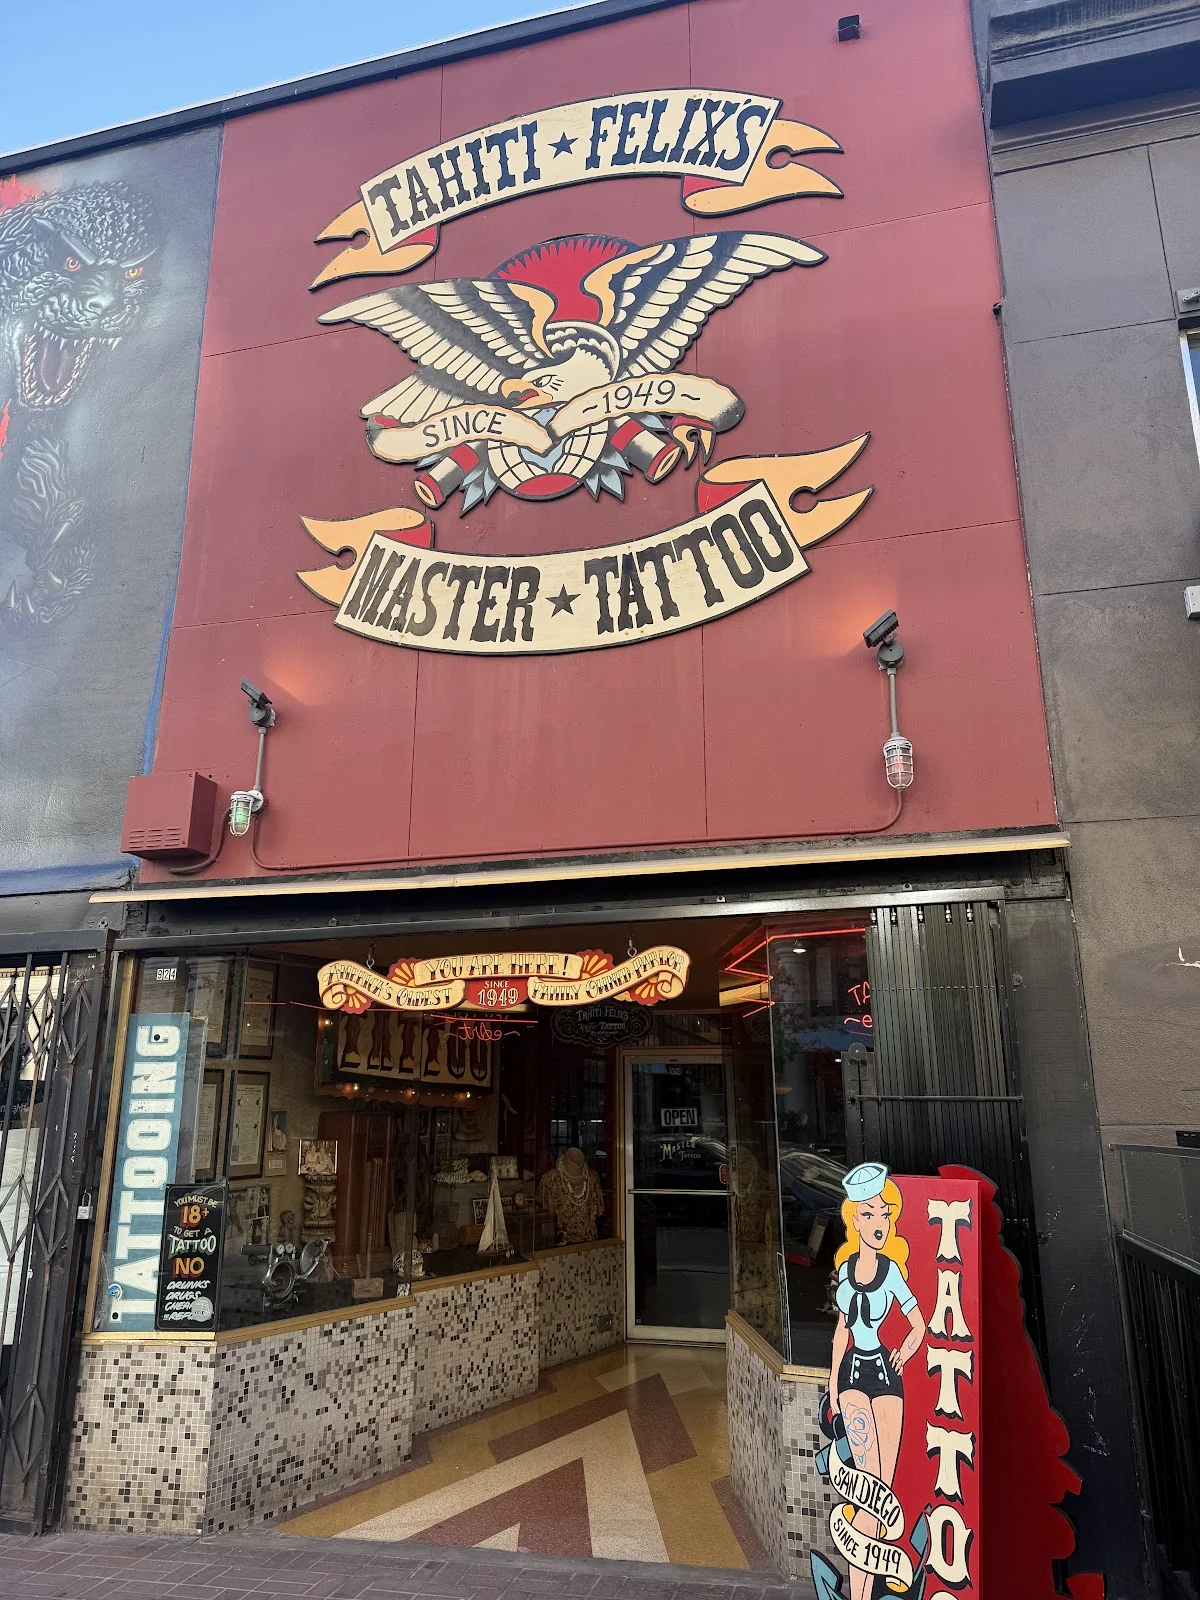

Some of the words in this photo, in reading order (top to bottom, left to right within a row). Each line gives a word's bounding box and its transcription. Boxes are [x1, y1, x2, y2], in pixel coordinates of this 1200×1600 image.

[367, 120, 541, 237] TAHITI
[584, 97, 772, 172] FELIX'S
[422, 410, 507, 448] SINCE
[344, 544, 541, 644] MASTER
[584, 498, 797, 635] TATTOO
[156, 968, 177, 981] 924
[425, 956, 464, 981] YOU
[466, 954, 504, 976] ARE
[508, 953, 569, 976] HERE!
[531, 981, 582, 1001] FAMILY
[585, 966, 631, 999] OWNED
[632, 949, 685, 979] PARLOR
[322, 962, 392, 1001] AMERICA'S
[396, 987, 452, 1007] OLDEST
[484, 980, 509, 989] SINCE
[477, 988, 518, 1008] 1949
[664, 1109, 695, 1125] OPEN
[108, 1024, 181, 1324] TATTOOING
[173, 1196, 187, 1208] YOU
[187, 1195, 207, 1205] MUST
[207, 1199, 219, 1208] BE
[182, 1204, 210, 1226] 18+
[173, 1225, 183, 1235] TO
[184, 1229, 200, 1238] GET
[204, 1227, 213, 1236] A
[169, 1234, 217, 1255] TATTOO
[174, 1257, 205, 1276] NO
[165, 1290, 202, 1300] DRUGS
[166, 1280, 211, 1290] DRUNKS
[926, 1198, 976, 1600] TATTO
[833, 1466, 859, 1500] SAN
[855, 1475, 901, 1528] DIEGO
[833, 1518, 860, 1558] SINCE
[864, 1542, 902, 1574] 1949
